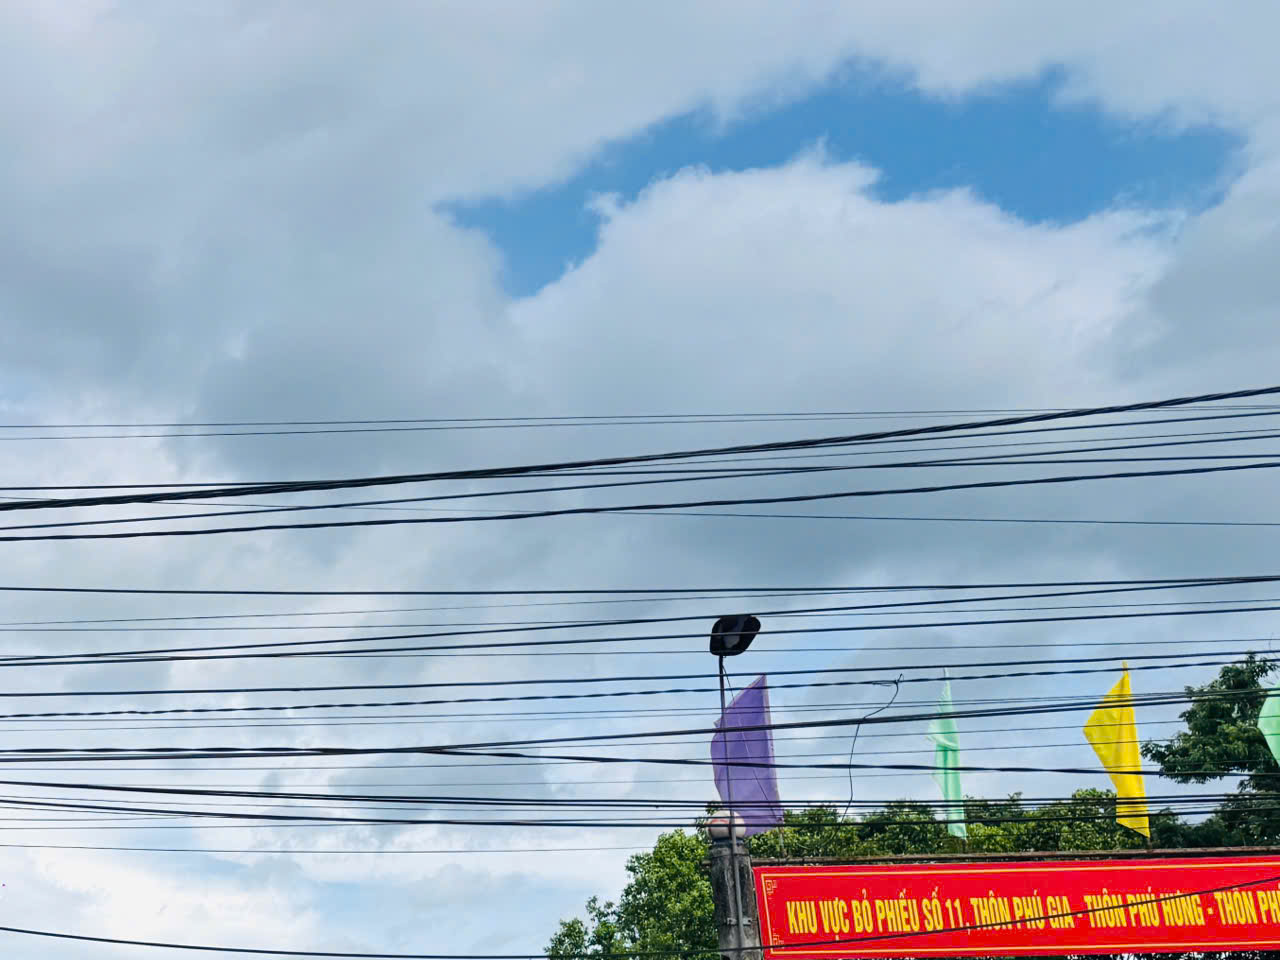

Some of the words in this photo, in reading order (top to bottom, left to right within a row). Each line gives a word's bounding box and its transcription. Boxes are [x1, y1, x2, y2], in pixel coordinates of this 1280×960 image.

[786, 900, 818, 934] KHU
[819, 897, 849, 941] VỰC
[851, 888, 874, 933] BỎ
[875, 888, 920, 933] PHIẾU
[922, 886, 944, 932] SỐ
[970, 890, 1013, 931] THÔN
[1013, 889, 1046, 930] PHÚ
[1047, 895, 1075, 929] GIA
[1084, 888, 1127, 928] THÔN
[1126, 886, 1160, 927] PHÚ
[1214, 888, 1258, 925] THÔN
[1257, 883, 1280, 925] PH
